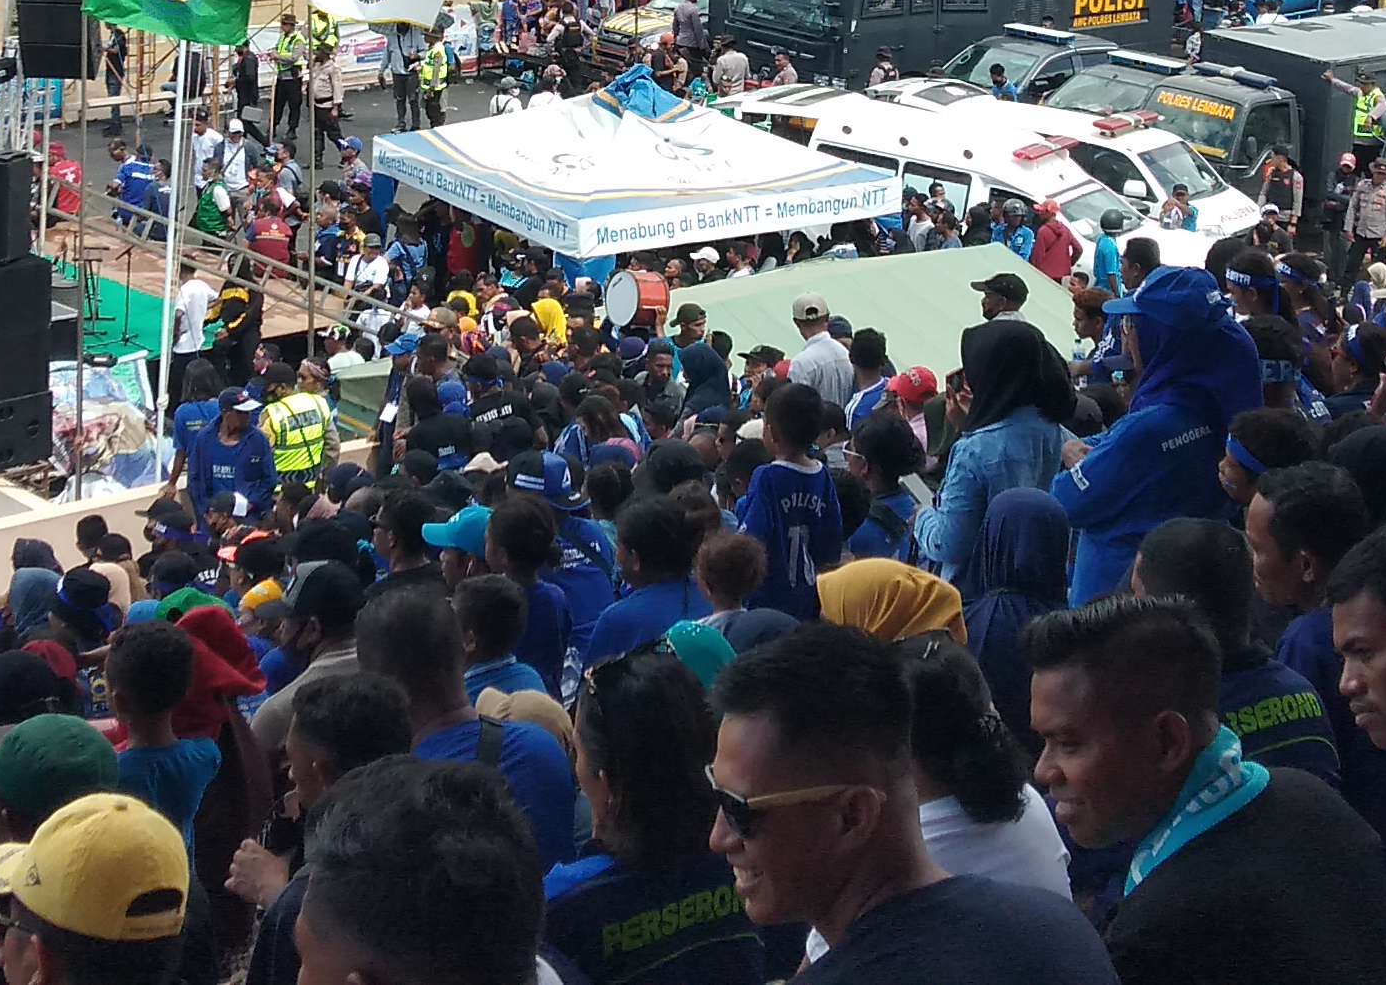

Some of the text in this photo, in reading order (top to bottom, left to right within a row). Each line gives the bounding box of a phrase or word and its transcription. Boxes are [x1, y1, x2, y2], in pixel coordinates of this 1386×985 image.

[1088, 13, 1113, 26] POLRES
[1112, 10, 1142, 23] LEMBATA
[1157, 90, 1236, 122] POLRES LEMBATA
[378, 149, 425, 185] Menabung
[426, 170, 435, 186] di
[436, 172, 479, 204] BankNTT
[487, 193, 546, 232] Membangun
[547, 216, 570, 241] NTT
[596, 215, 676, 246] Menabung
[679, 215, 694, 233] di
[697, 205, 761, 230] BankNTT
[776, 195, 859, 220] Membangun
[861, 187, 889, 208] NTT
